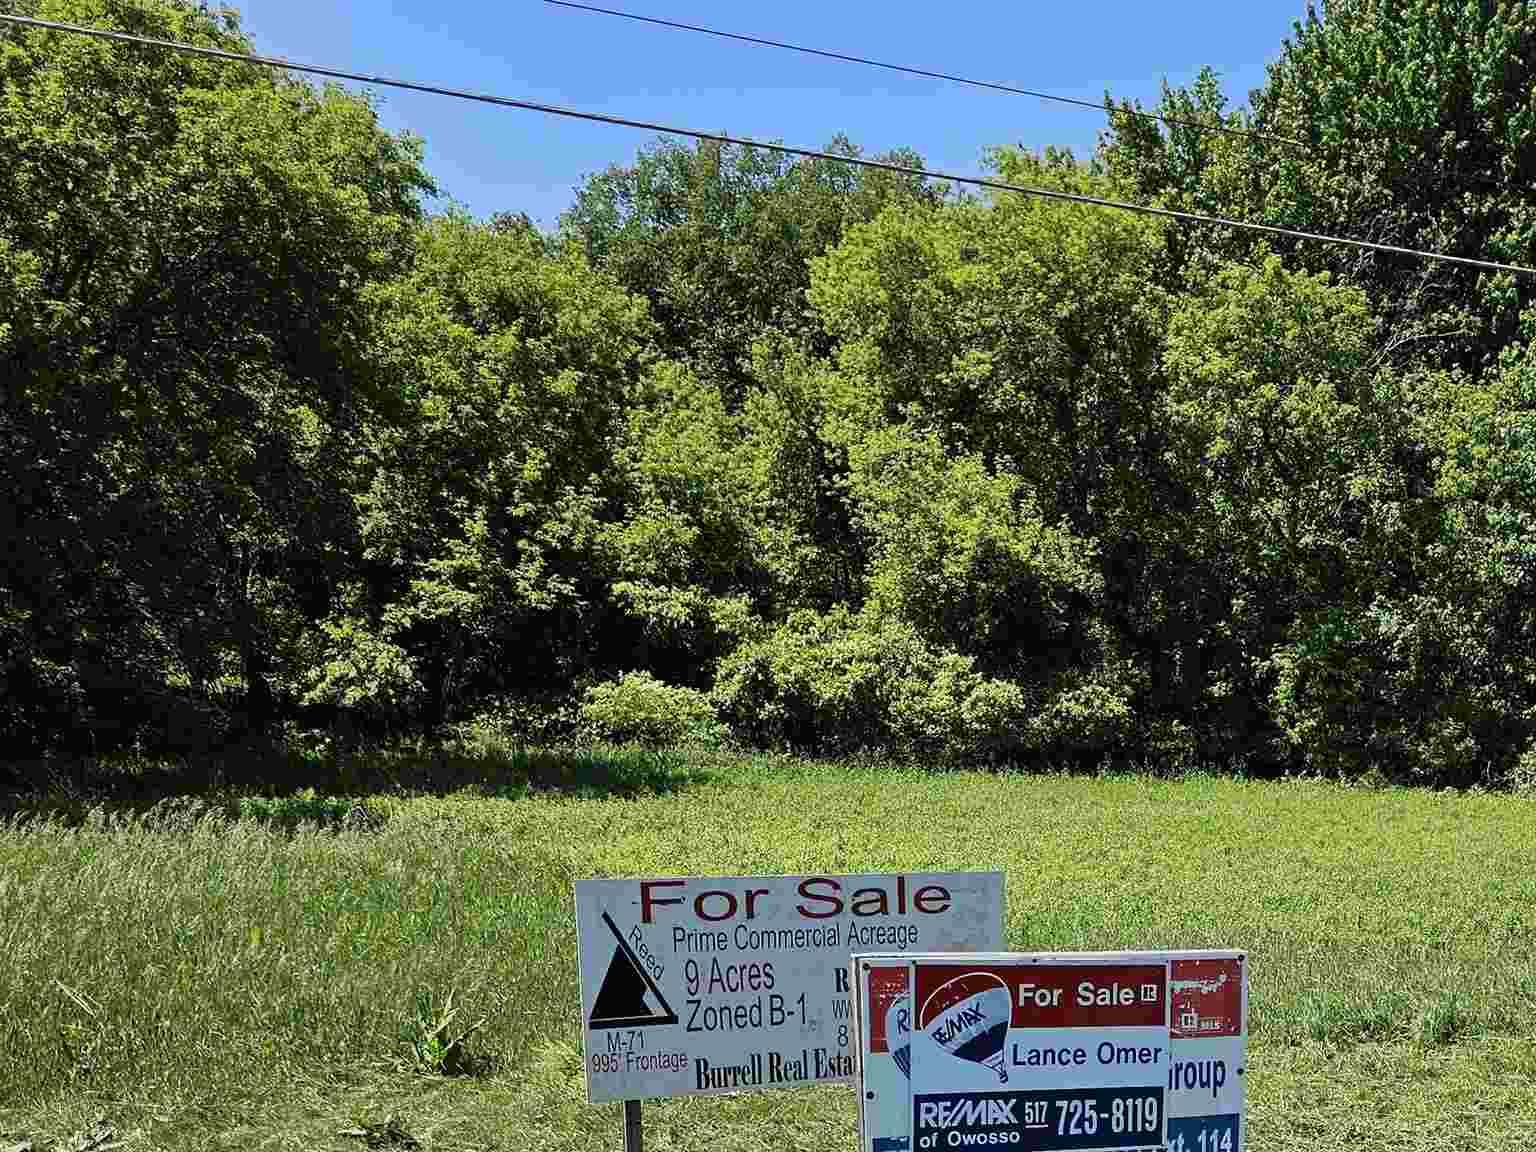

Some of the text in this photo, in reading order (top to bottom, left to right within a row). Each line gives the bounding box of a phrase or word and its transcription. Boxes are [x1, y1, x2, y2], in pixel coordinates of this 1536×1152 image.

[640, 876, 951, 924] For Sale
[629, 924, 664, 981] Reed
[673, 920, 918, 952] Prime Commercial Acreage
[685, 957, 774, 996] 9 Acres
[1018, 981, 1135, 1006] For Sale
[687, 996, 762, 1032] Zoned
[769, 993, 807, 1025] B-1
[931, 1002, 986, 1043] RE/MAX
[607, 1031, 644, 1053] M-71
[1012, 1041, 1162, 1066] Lance Omer
[626, 1050, 688, 1073] Frontage
[696, 1053, 762, 1089] Burrell
[768, 1050, 808, 1083] Real
[1168, 1060, 1226, 1098] roup
[920, 1097, 1158, 1135] RE/MAX 517 725-8119
[920, 1130, 1020, 1148] of Owosso
